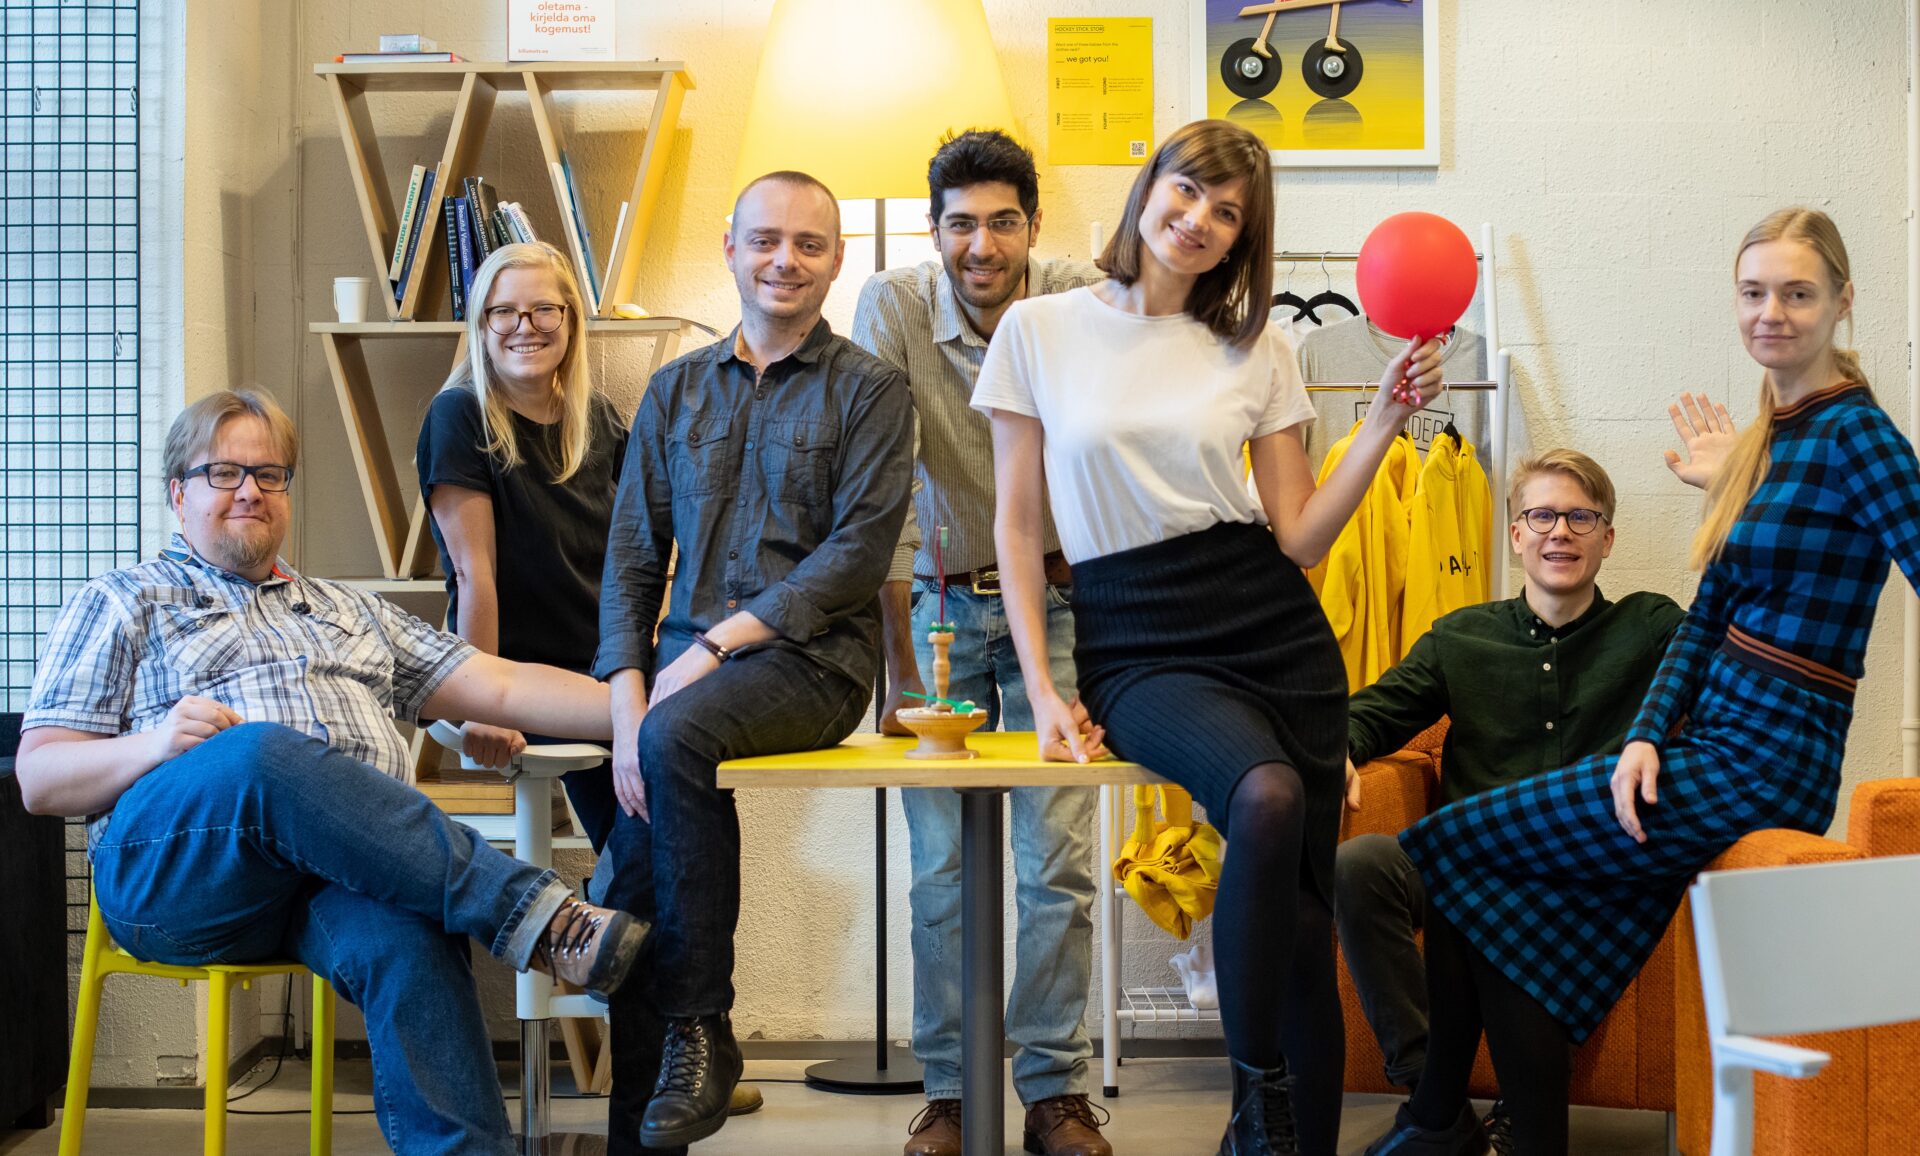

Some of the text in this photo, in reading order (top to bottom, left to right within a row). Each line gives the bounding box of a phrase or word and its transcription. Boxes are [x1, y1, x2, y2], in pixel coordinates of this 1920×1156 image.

[538, 1, 581, 11] oletama
[530, 12, 569, 24] kirjelda
[535, 24, 591, 36] kogemust!
[1079, 56, 1091, 64] got
[394, 223, 408, 264] AUTODE
[405, 180, 417, 223] REMONT
[469, 185, 490, 251] LONDON UNDERGROUND
[458, 204, 469, 270] Beautiful Visualization
